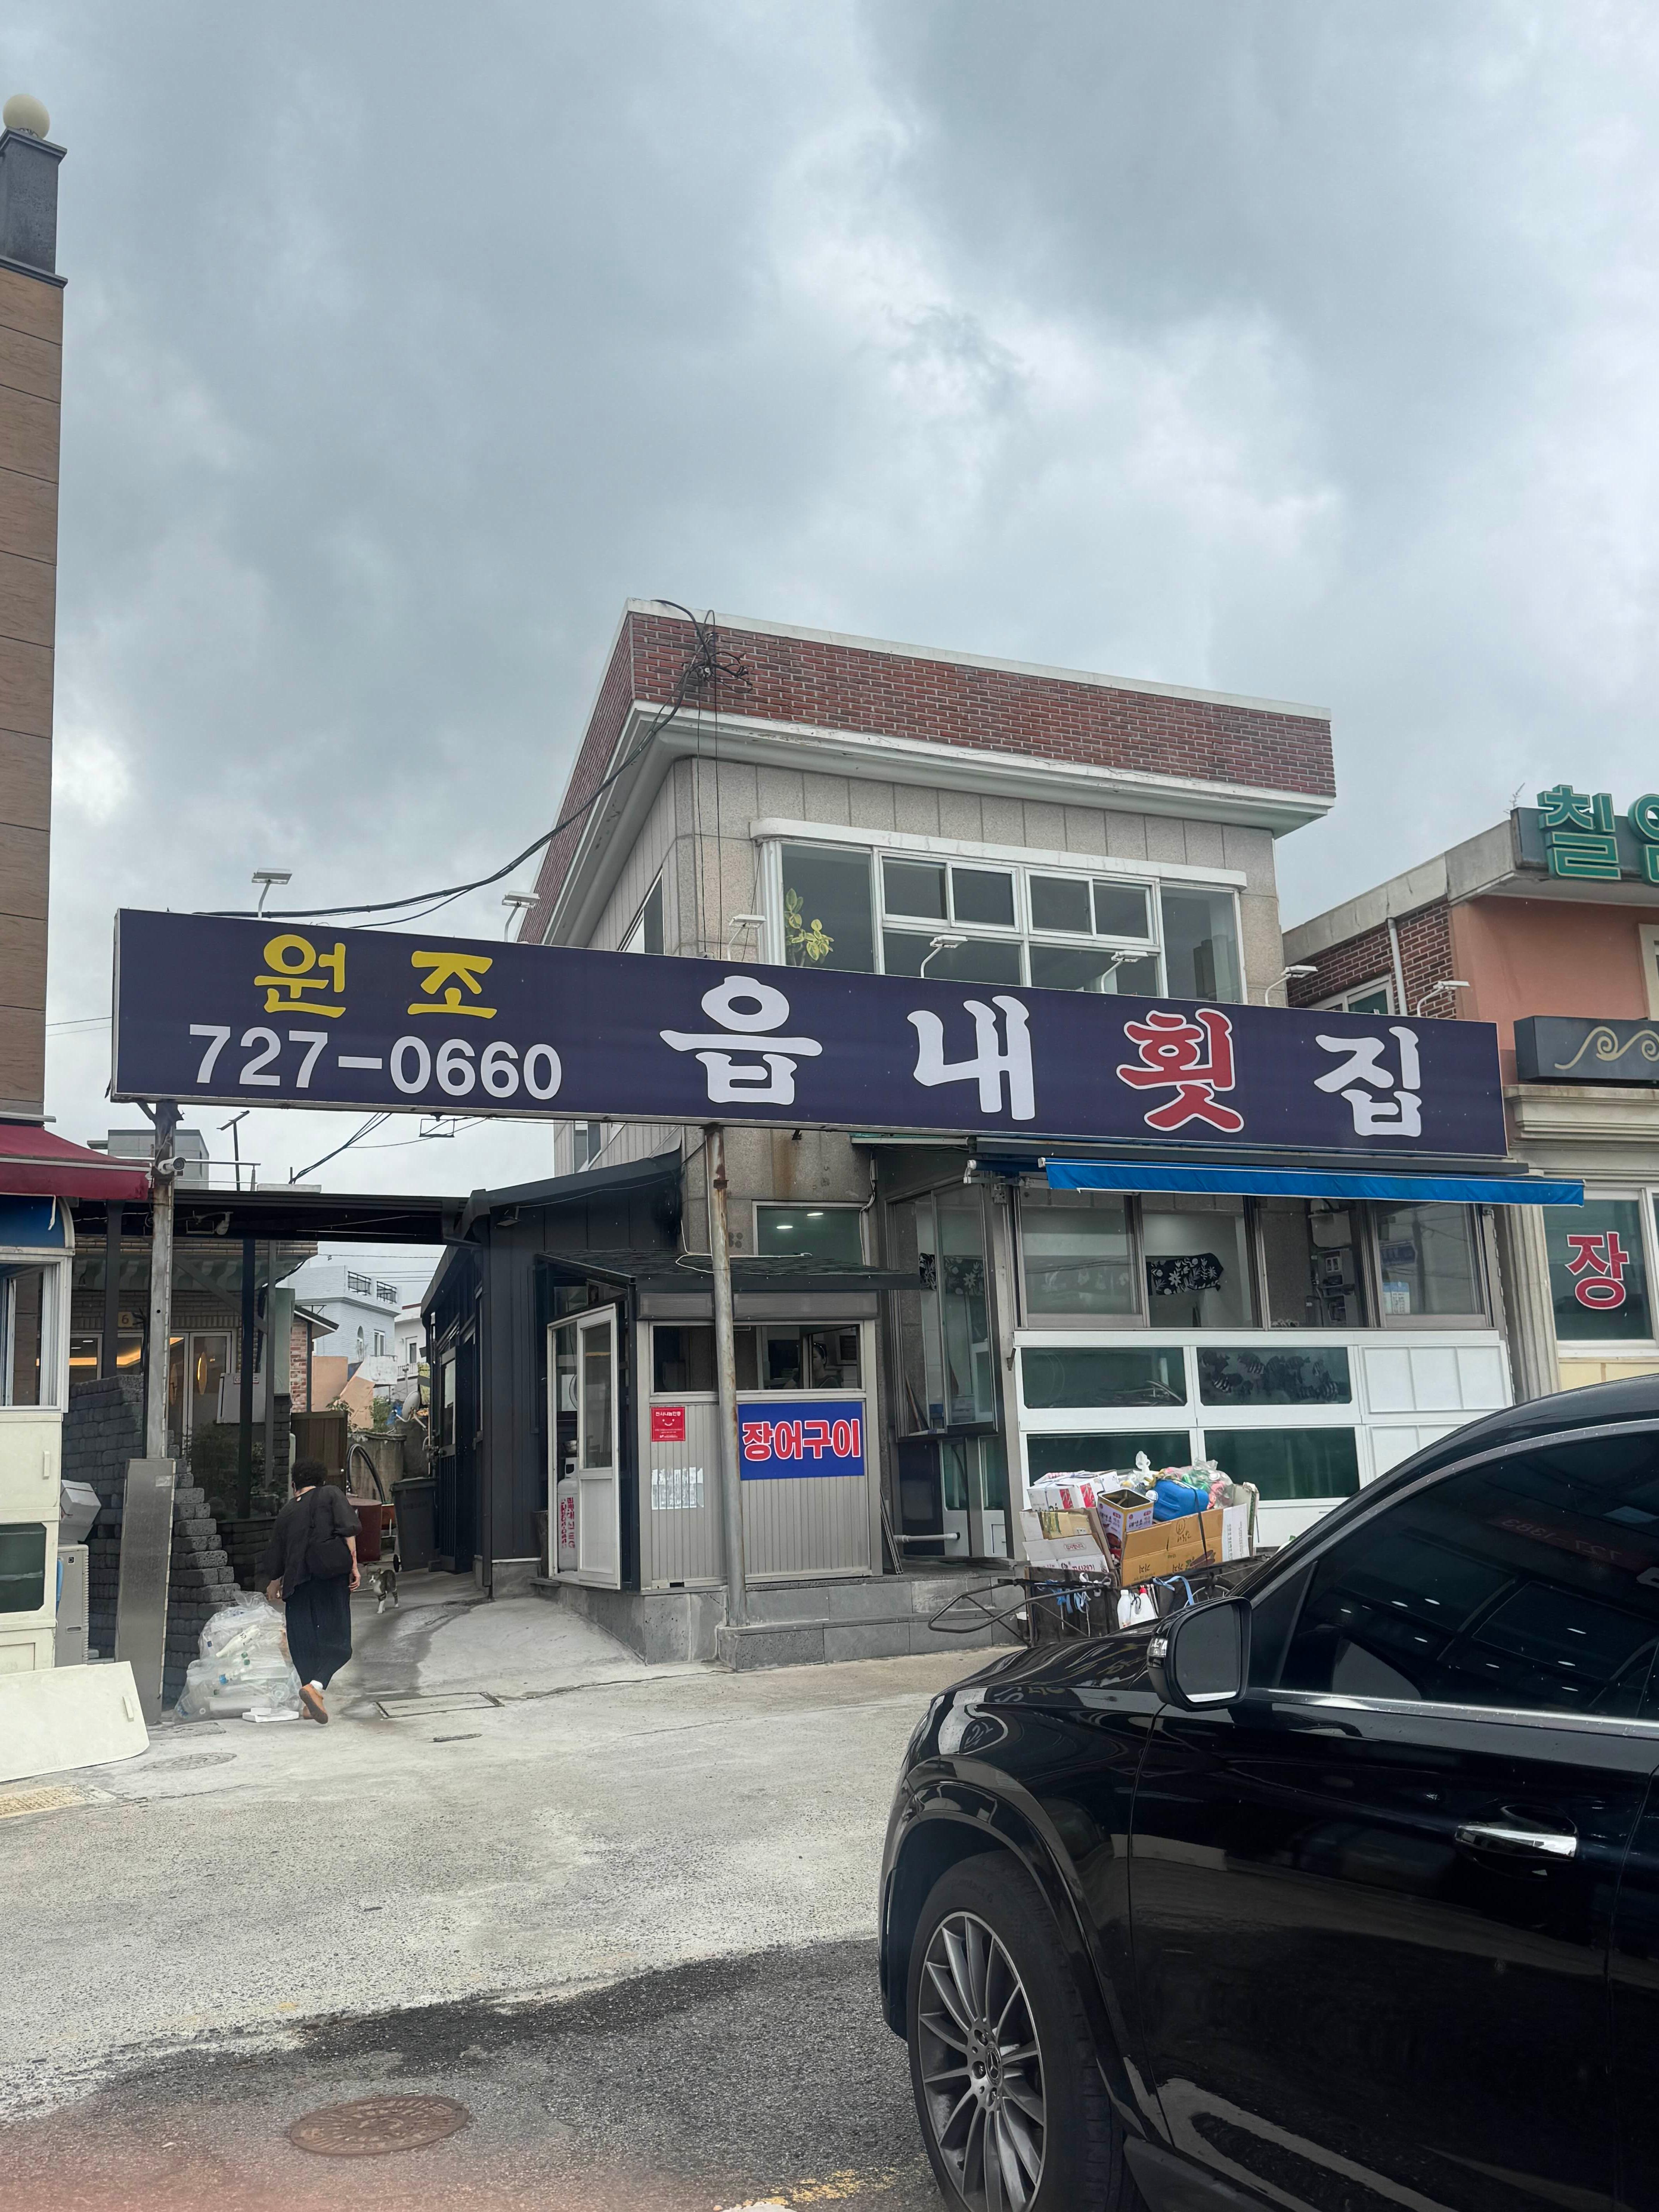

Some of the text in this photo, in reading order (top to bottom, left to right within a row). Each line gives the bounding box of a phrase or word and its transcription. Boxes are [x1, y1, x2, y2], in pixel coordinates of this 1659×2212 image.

[254, 934, 497, 1019] 원조
[189, 1023, 562, 1101] 727-0660
[659, 975, 1422, 1137] 읍내횟집
[1565, 1231, 1630, 1310] 장
[122, 1314, 129, 1324] 6
[742, 1419, 861, 1461] 장어구이
